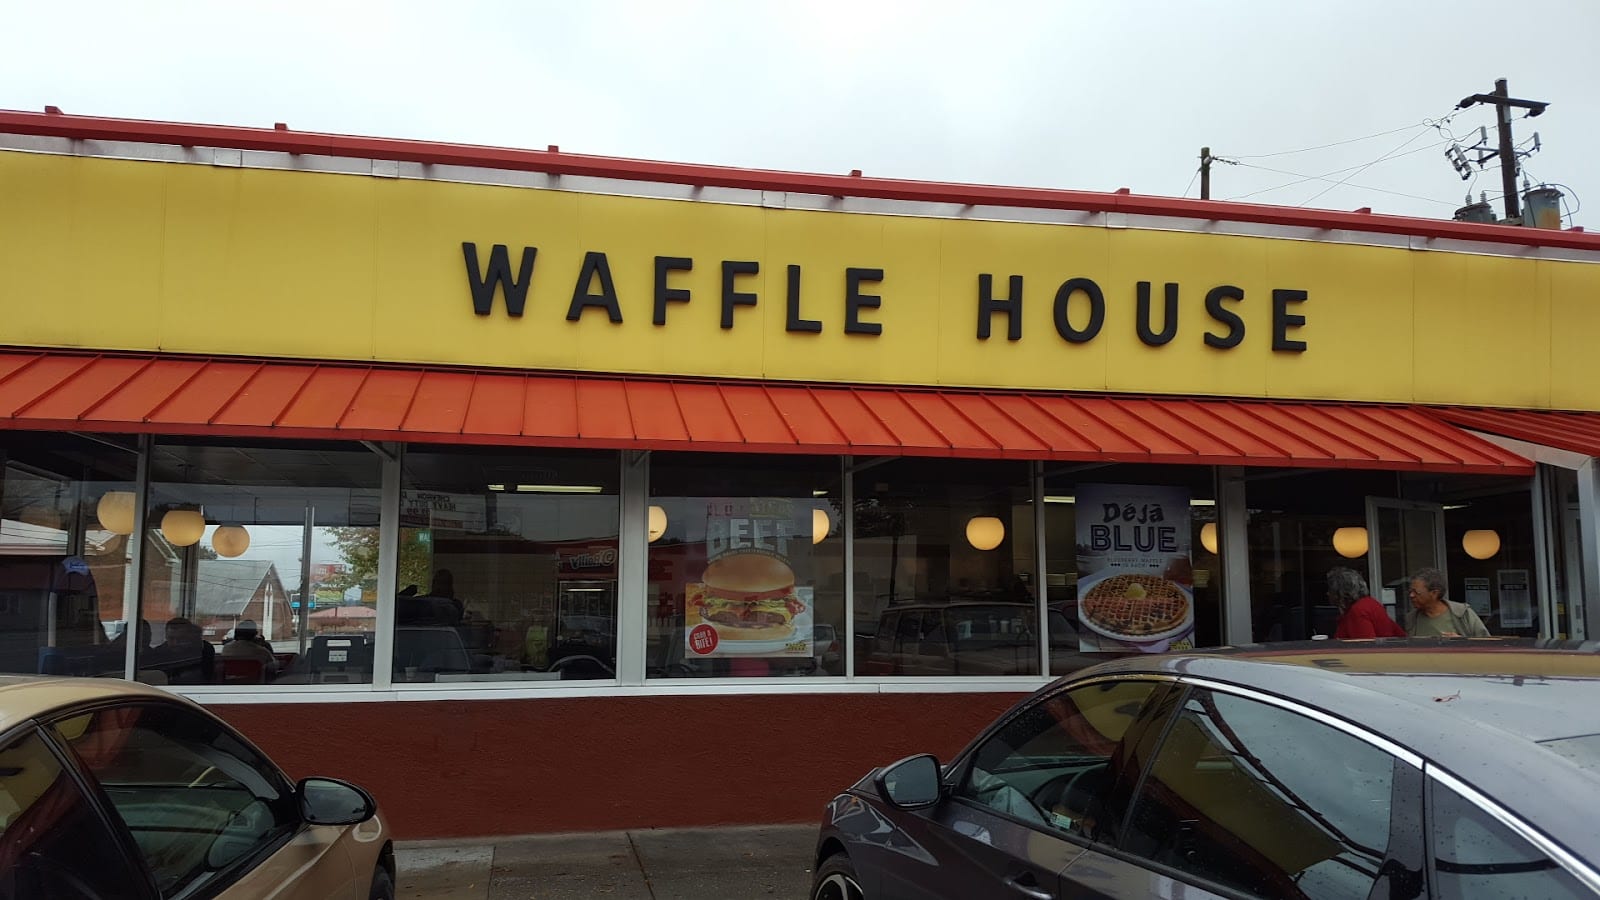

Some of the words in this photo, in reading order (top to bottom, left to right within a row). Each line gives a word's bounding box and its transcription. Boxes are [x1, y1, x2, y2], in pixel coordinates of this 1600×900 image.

[462, 241, 885, 336] WAFFLE
[976, 273, 1309, 354] HOUSE
[706, 518, 797, 559] BEEF
[1090, 524, 1178, 553] BLUE
